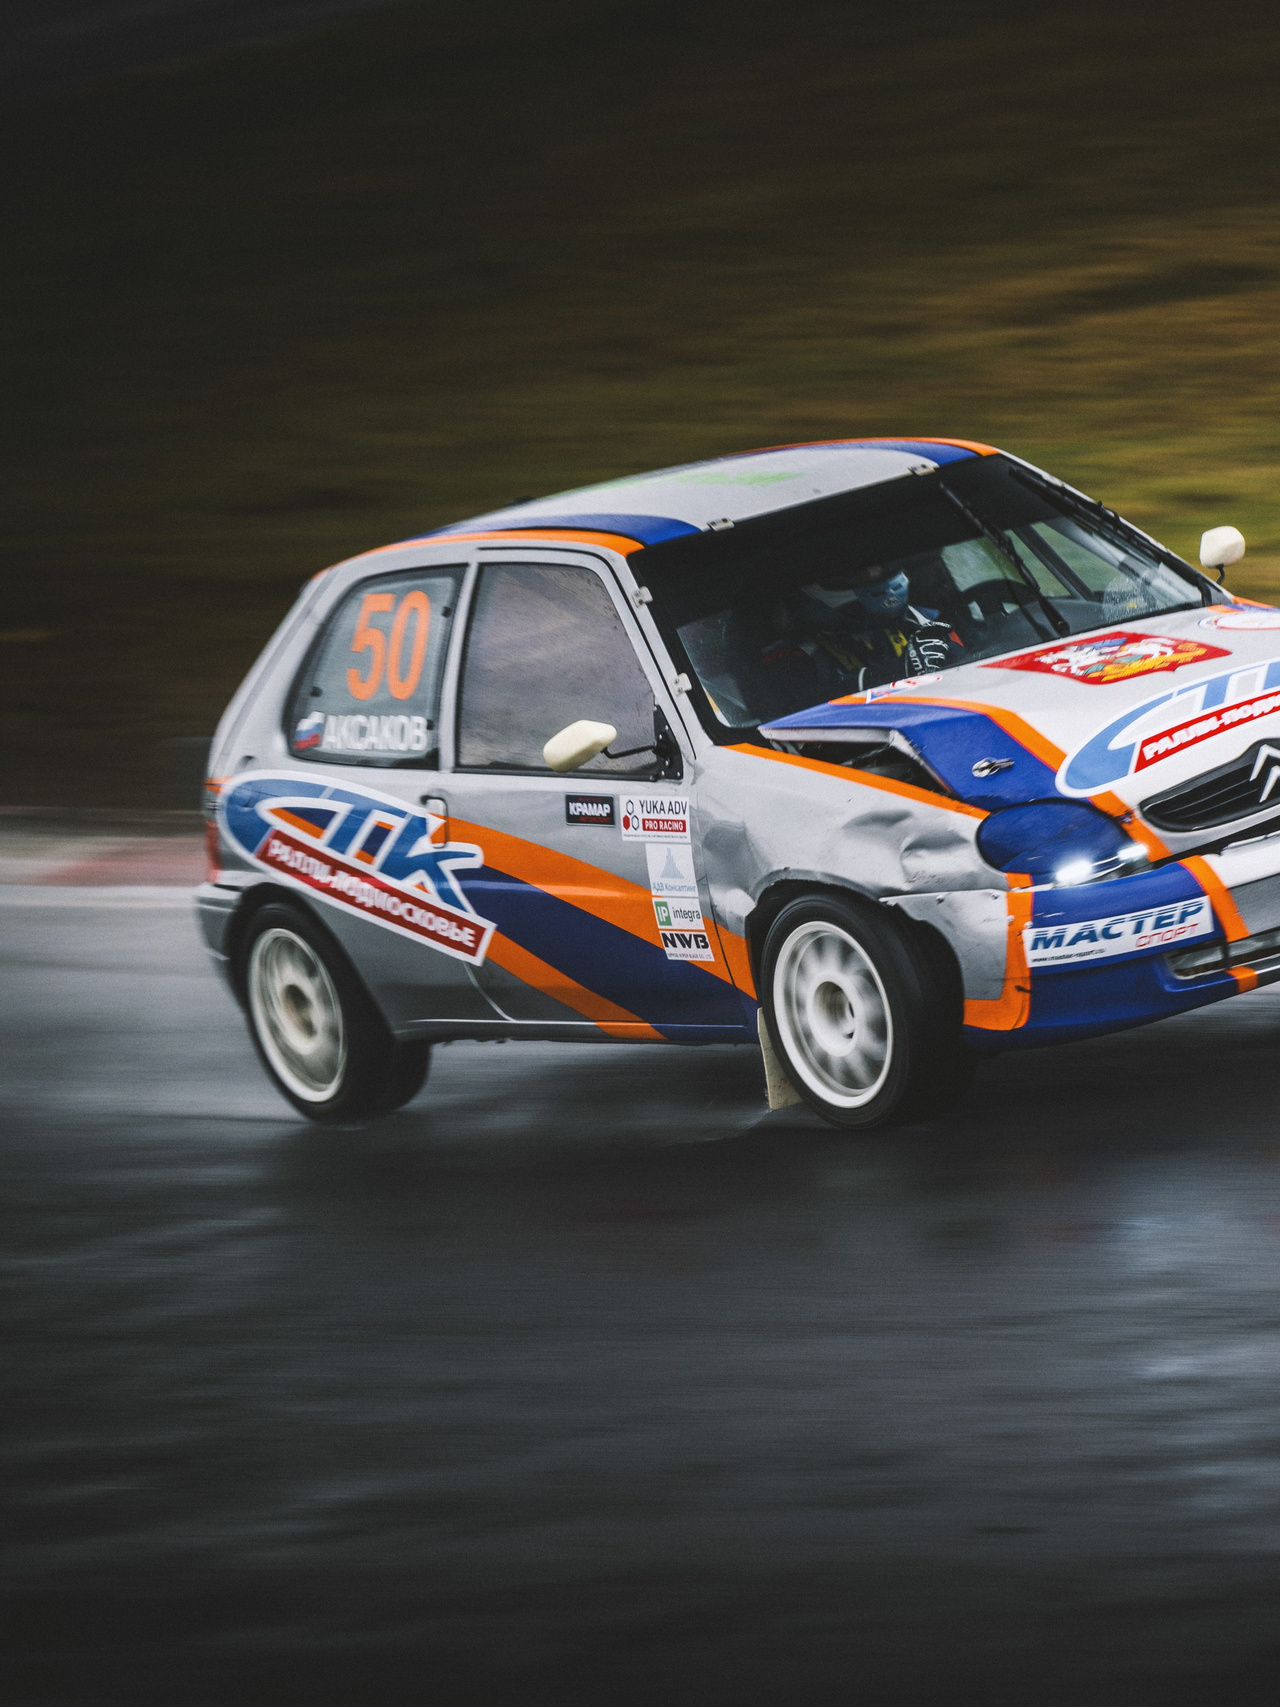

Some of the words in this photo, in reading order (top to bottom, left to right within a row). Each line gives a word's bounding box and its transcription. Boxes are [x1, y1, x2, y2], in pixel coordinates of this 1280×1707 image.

[346, 590, 431, 700] 50
[323, 714, 428, 750] АКСАКОВ
[569, 802, 611, 817] КРАМАР
[639, 799, 666, 815] YUKA
[667, 800, 688, 816] ADV
[644, 819, 658, 830] PRO
[659, 820, 684, 832] RACING
[225, 778, 478, 914] СТК
[267, 838, 476, 948] РАЛЛИ-ПОДМОСКОВЬЕ
[657, 905, 669, 922] IP
[672, 907, 701, 923] integra
[1030, 900, 1205, 951] МАСТЕР
[660, 932, 710, 950] NWB
[1135, 922, 1200, 948] СПОРТ
